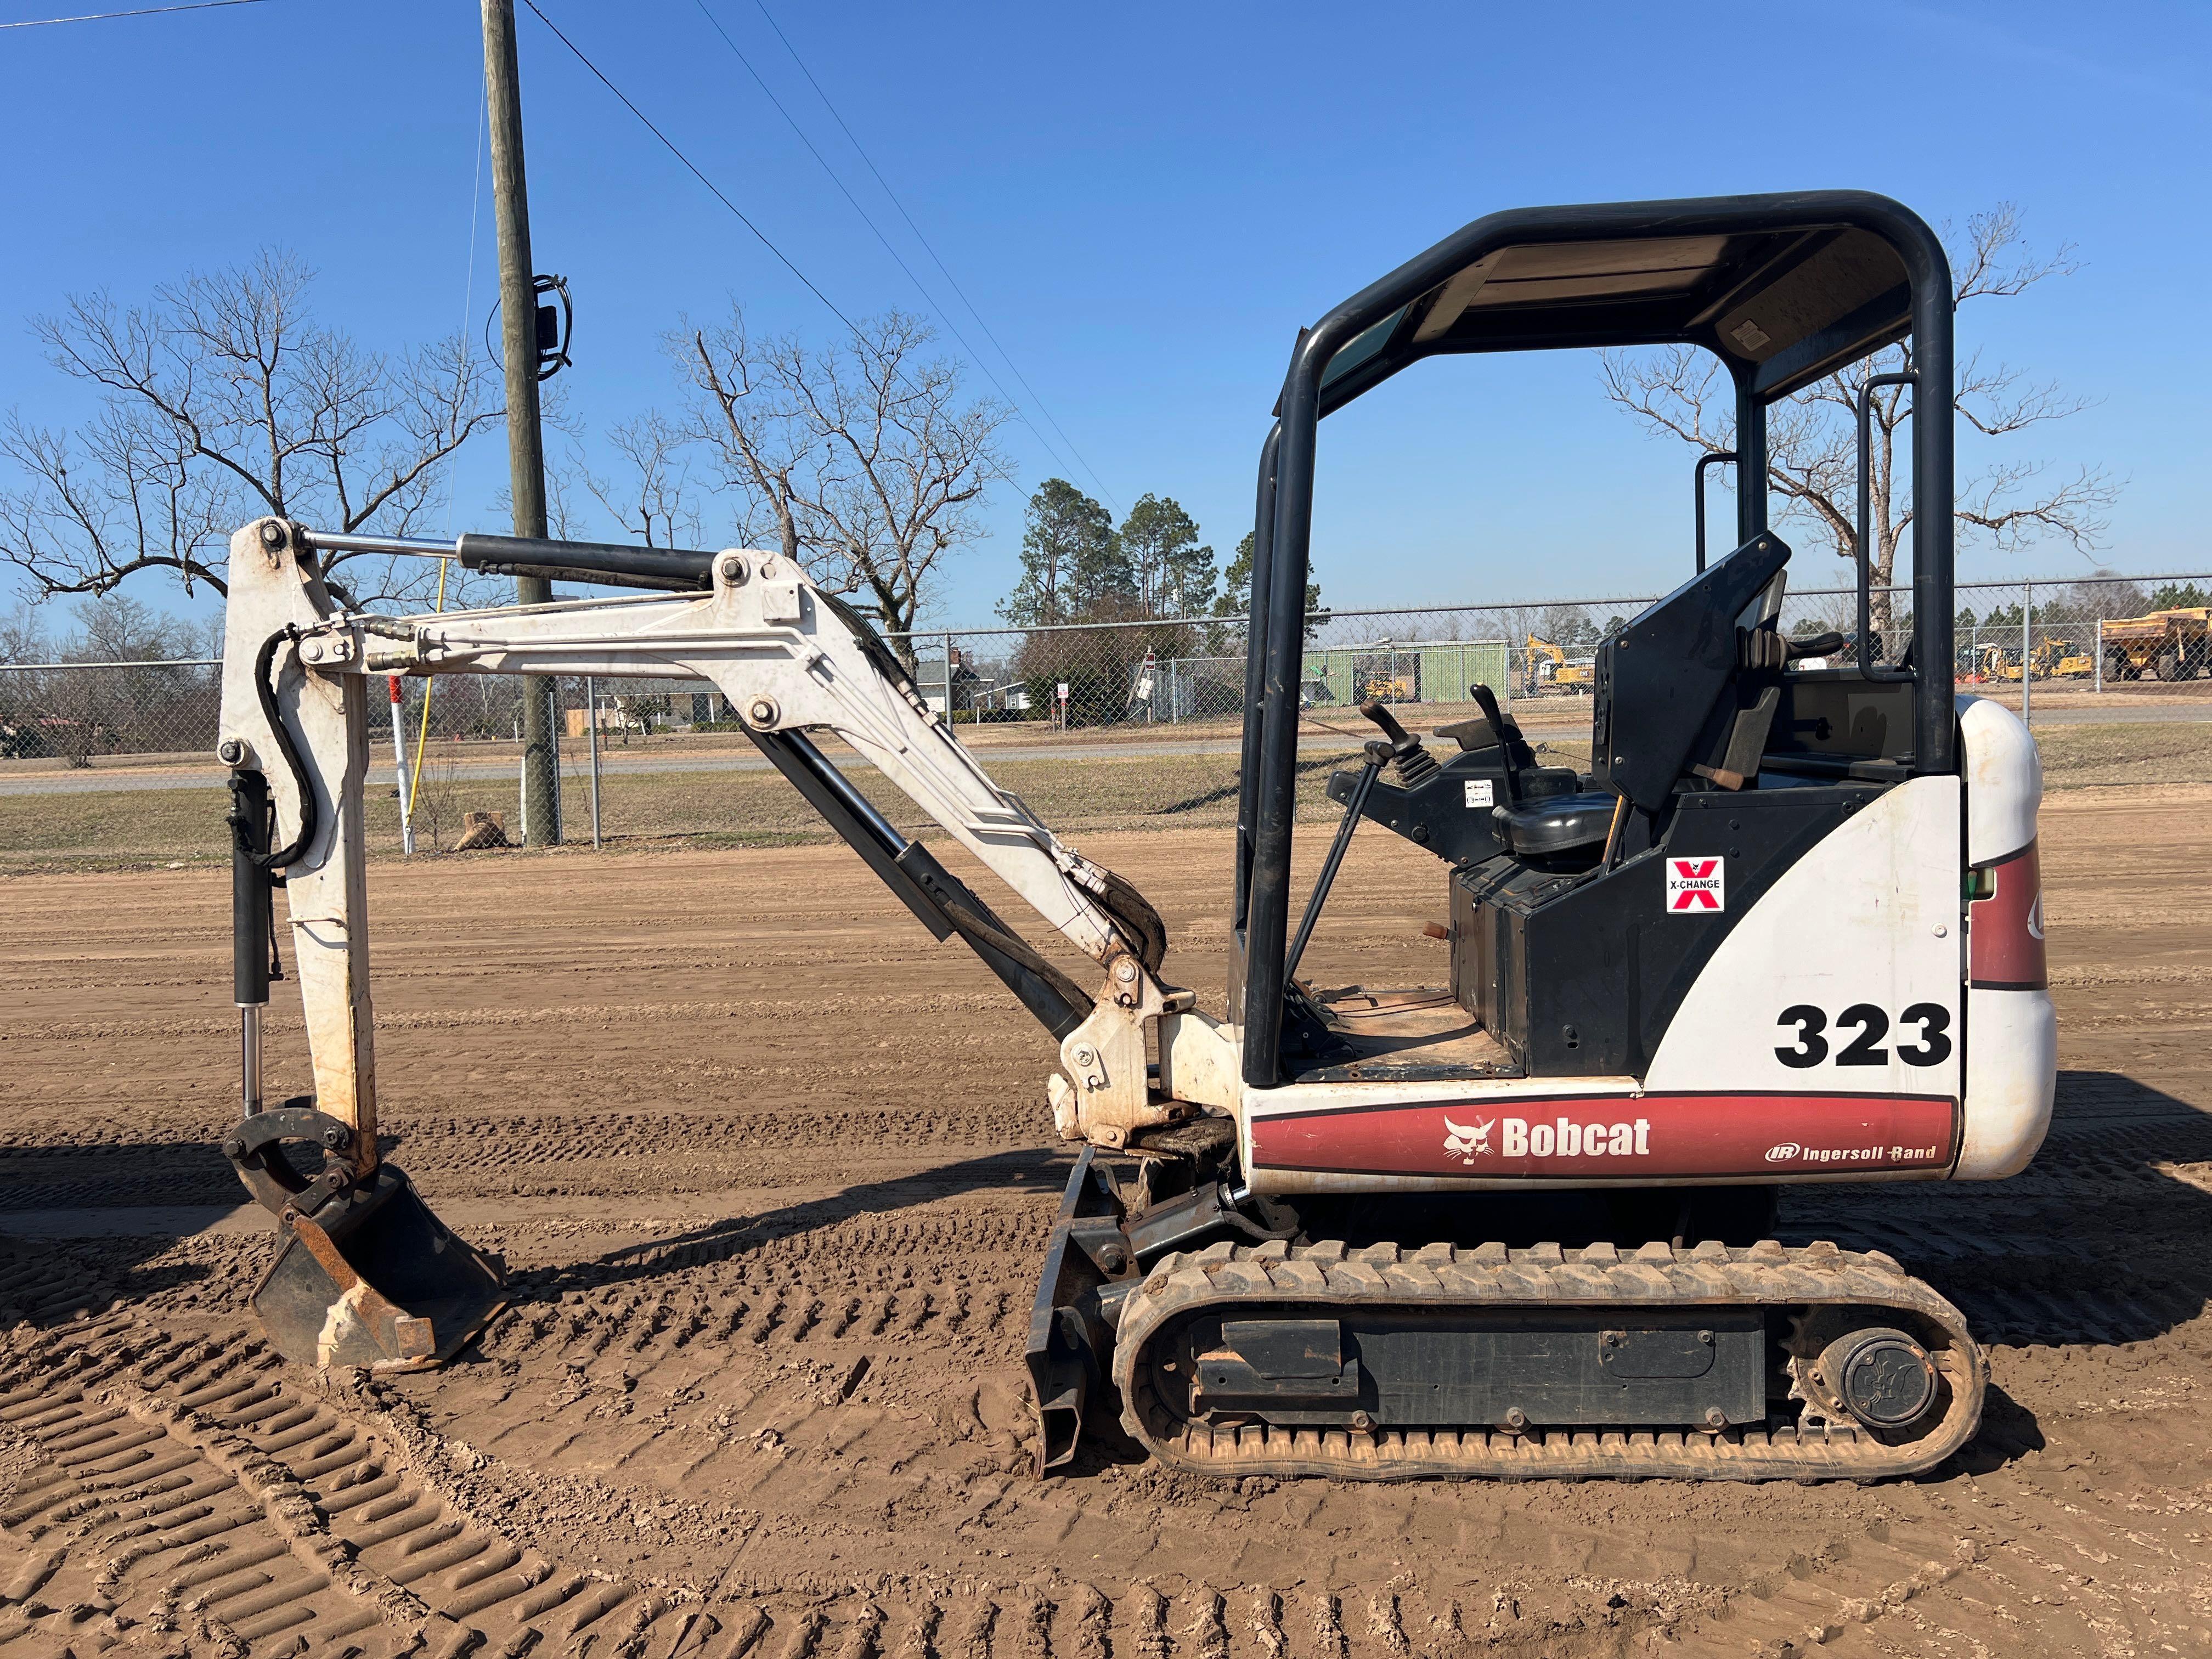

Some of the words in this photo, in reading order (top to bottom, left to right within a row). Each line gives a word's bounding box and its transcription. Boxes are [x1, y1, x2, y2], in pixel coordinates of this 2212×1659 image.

[1670, 879, 1720, 889] X-CHANGE
[1774, 1002, 1952, 1069] 323
[1502, 1117, 1650, 1157] Bobcat
